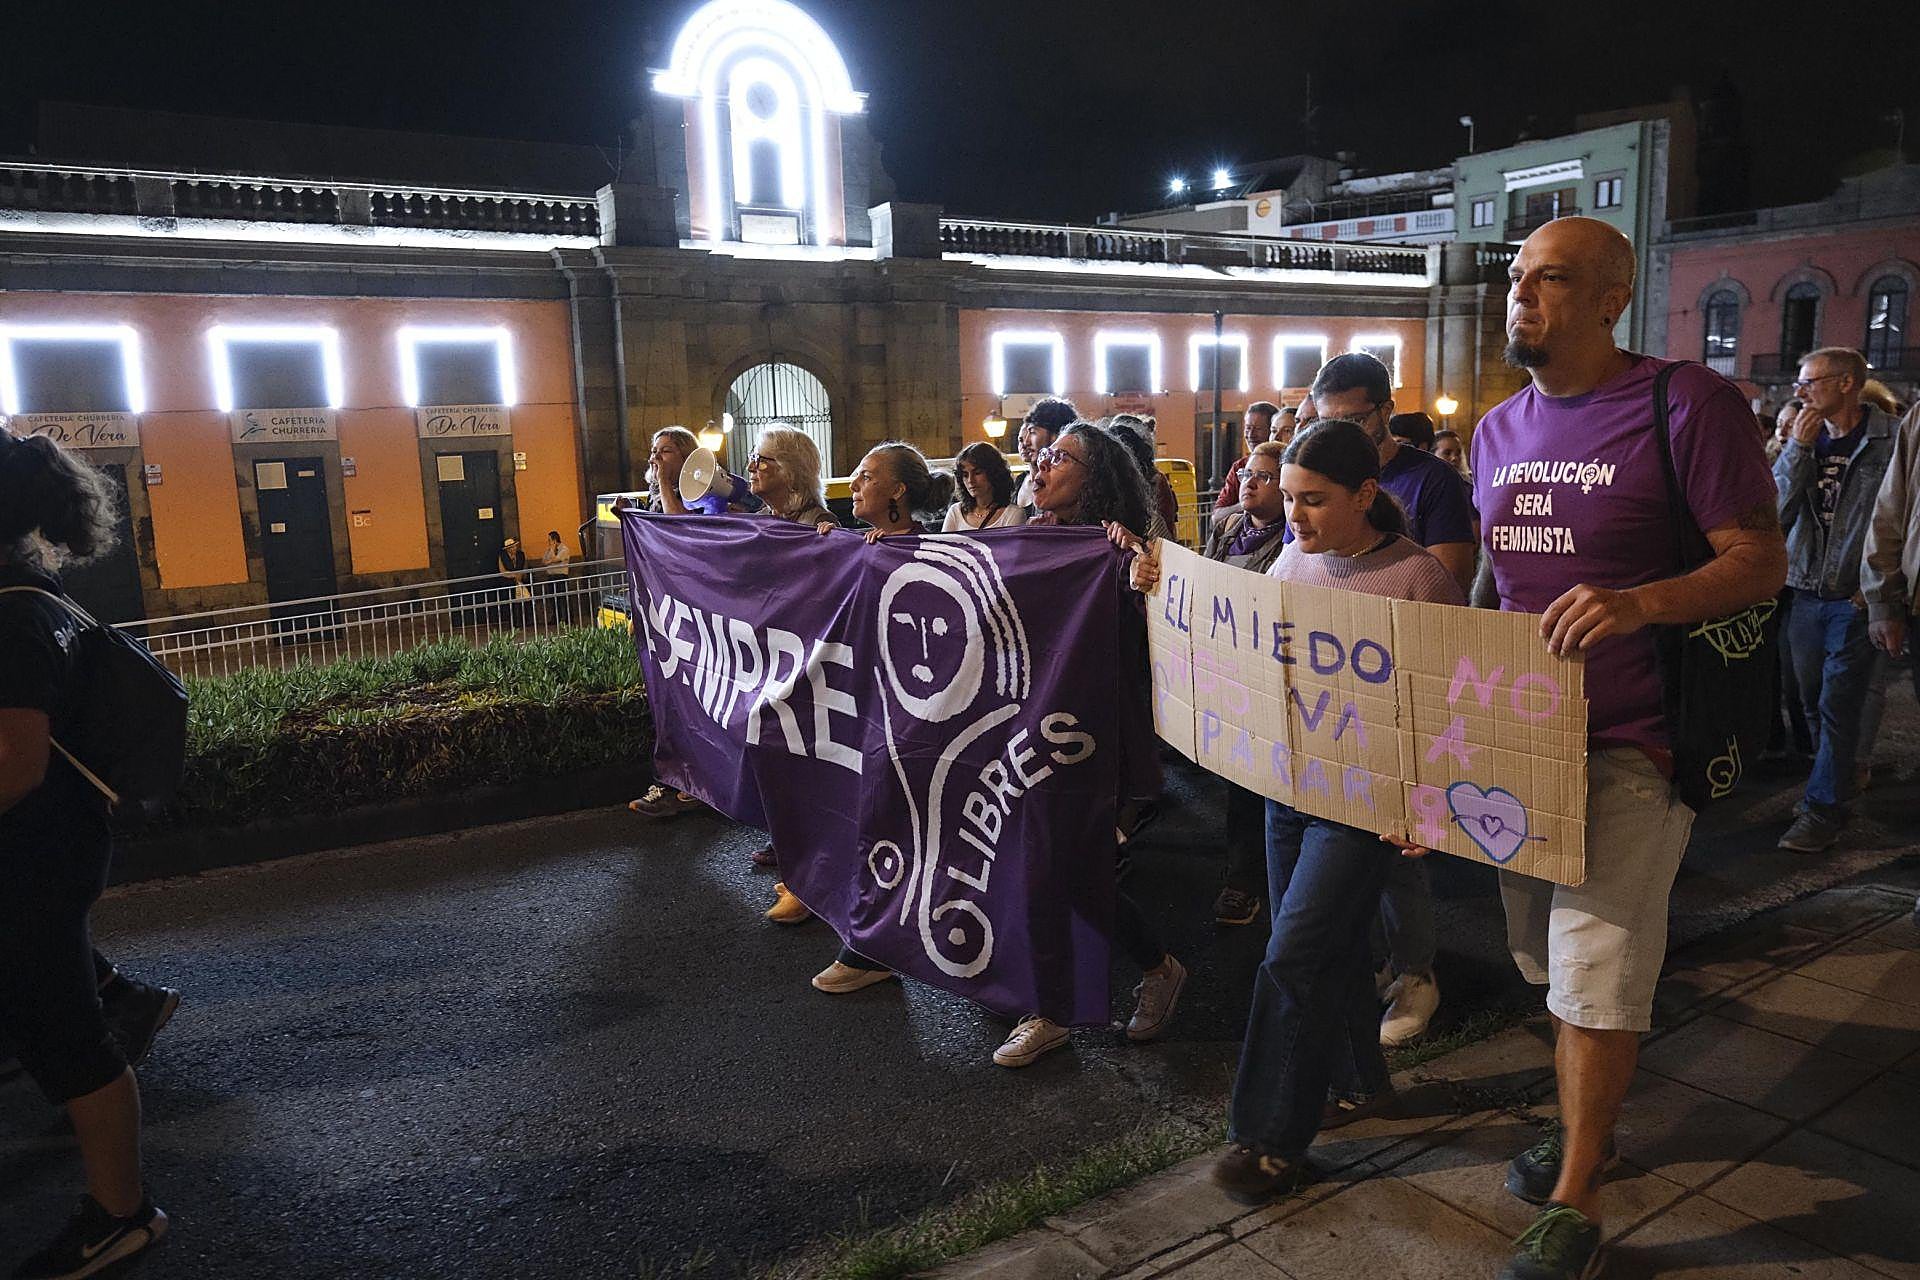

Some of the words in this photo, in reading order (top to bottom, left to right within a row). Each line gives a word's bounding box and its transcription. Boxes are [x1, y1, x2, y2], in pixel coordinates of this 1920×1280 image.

[28, 415, 74, 423] CAFETERIA
[77, 414, 125, 423] CHURRERIA
[271, 416, 325, 426] CAFETERIA
[271, 426, 326, 436] CHURRERIA
[426, 415, 458, 435] De
[460, 415, 500, 434] Vera
[74, 423, 127, 446] Vera
[1491, 466, 1508, 488] LA
[1506, 458, 1616, 495] REVOLUCIÓN
[1513, 488, 1552, 516] SERÁ
[1491, 526, 1577, 554] FEMINISTA
[1164, 574, 1190, 632] EL
[1447, 654, 1562, 720] NO
[1291, 686, 1370, 751] VA
[1424, 714, 1479, 772] A
[1202, 706, 1377, 813] PARAR
[946, 711, 1097, 894] LIBRES
